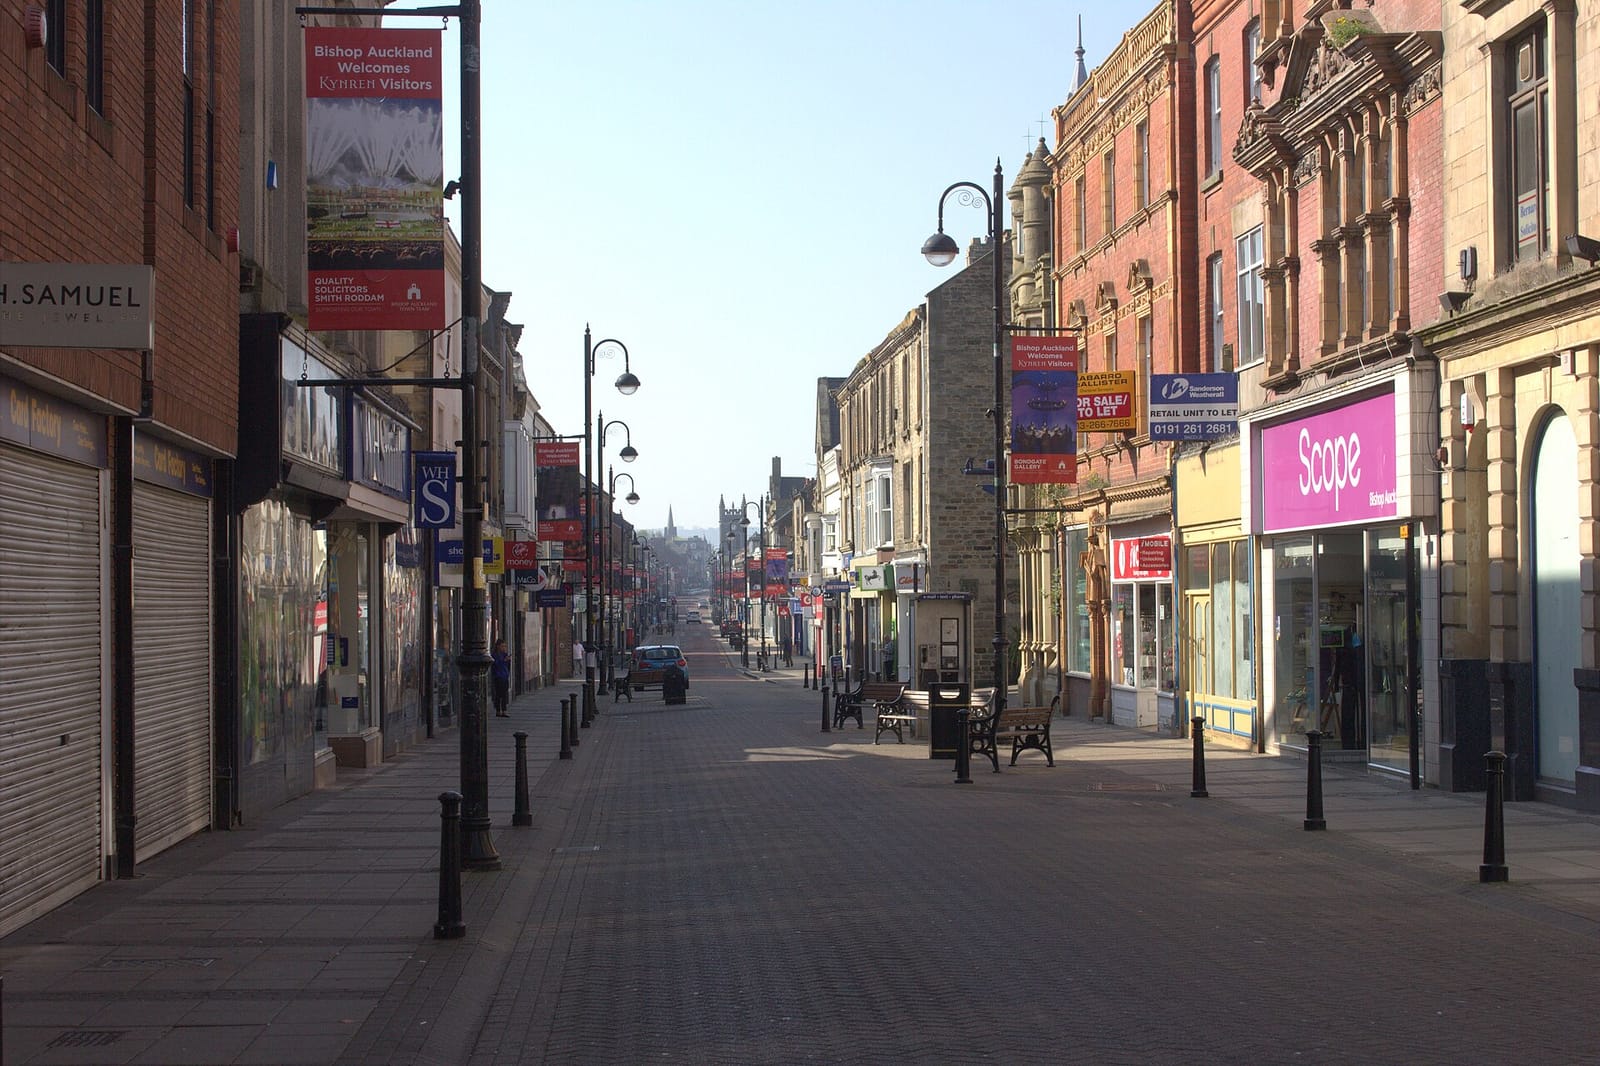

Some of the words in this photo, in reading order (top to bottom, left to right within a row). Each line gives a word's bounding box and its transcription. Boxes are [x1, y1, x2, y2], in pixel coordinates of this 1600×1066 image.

[314, 46, 363, 59] Bishop
[368, 46, 433, 58] Auckland
[337, 62, 410, 74] Welcomes
[380, 78, 433, 90] Visitors
[314, 277, 354, 286] QUALITY
[314, 285, 368, 294] SOLICITORS
[314, 294, 342, 302] SMITH
[344, 294, 385, 302] RODDAM
[1078, 379, 1128, 387] ALLISTER
[1080, 373, 1122, 381] ABARRO
[1077, 397, 1090, 407] OR
[1094, 394, 1128, 406] SALE/
[1078, 408, 1093, 418] TO
[1096, 406, 1117, 416] LET
[1154, 424, 1179, 434] 0191
[1184, 424, 1202, 434] 261
[1206, 424, 1231, 433] 2681
[422, 466, 449, 479] WH
[1299, 428, 1361, 512] Scope
[421, 479, 450, 524] S
[1369, 491, 1384, 508] Bishop
